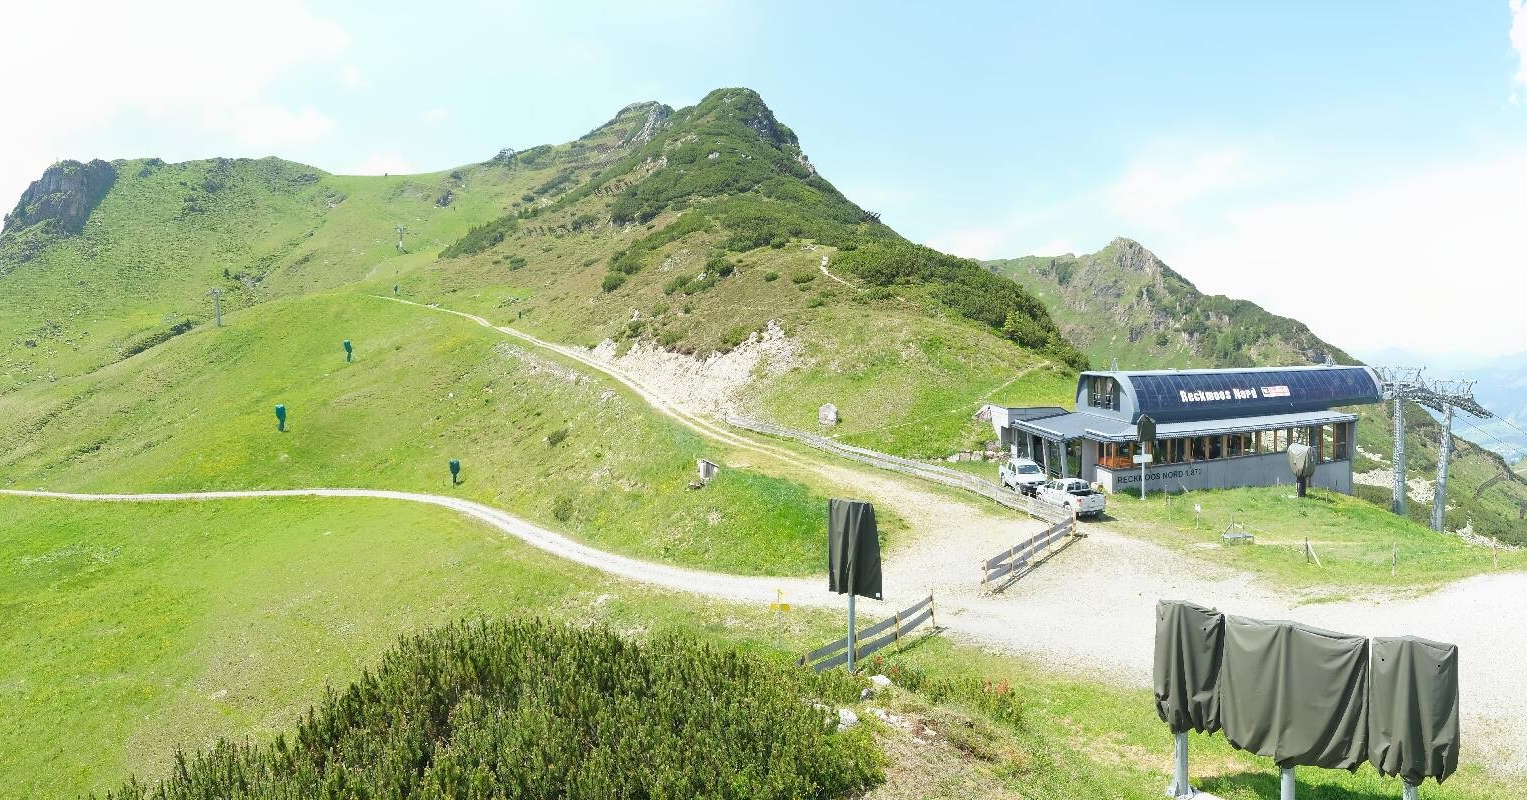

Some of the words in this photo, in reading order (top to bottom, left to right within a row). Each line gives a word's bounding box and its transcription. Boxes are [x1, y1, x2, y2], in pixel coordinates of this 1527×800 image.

[1179, 390, 1231, 402] Reckmoos
[1232, 387, 1257, 400] Nord
[1117, 472, 1161, 484] RECKMOOS
[1162, 470, 1183, 480] NORD
